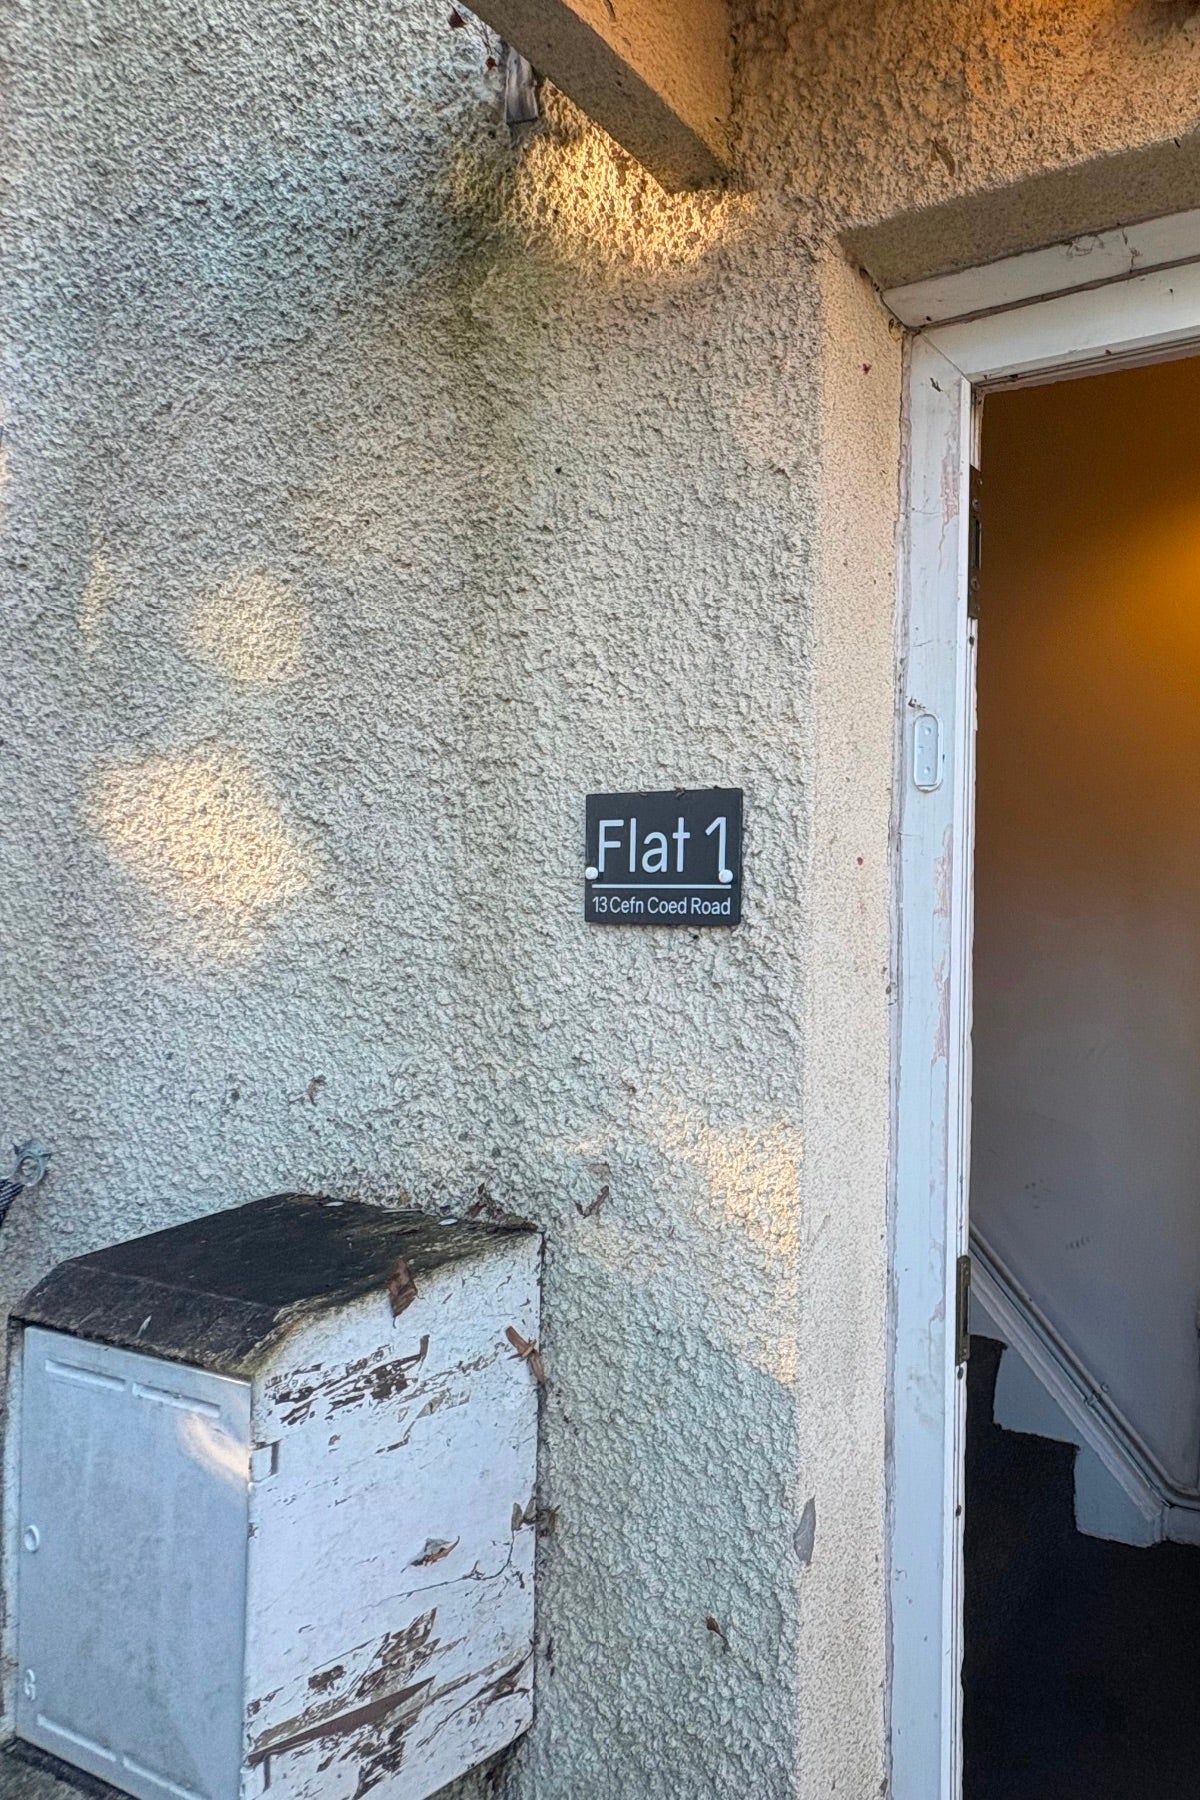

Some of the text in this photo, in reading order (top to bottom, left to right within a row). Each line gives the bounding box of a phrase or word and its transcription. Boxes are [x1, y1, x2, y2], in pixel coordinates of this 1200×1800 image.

[598, 816, 727, 873] Flat 1
[592, 896, 731, 915] 13 Cefn Coed Road
